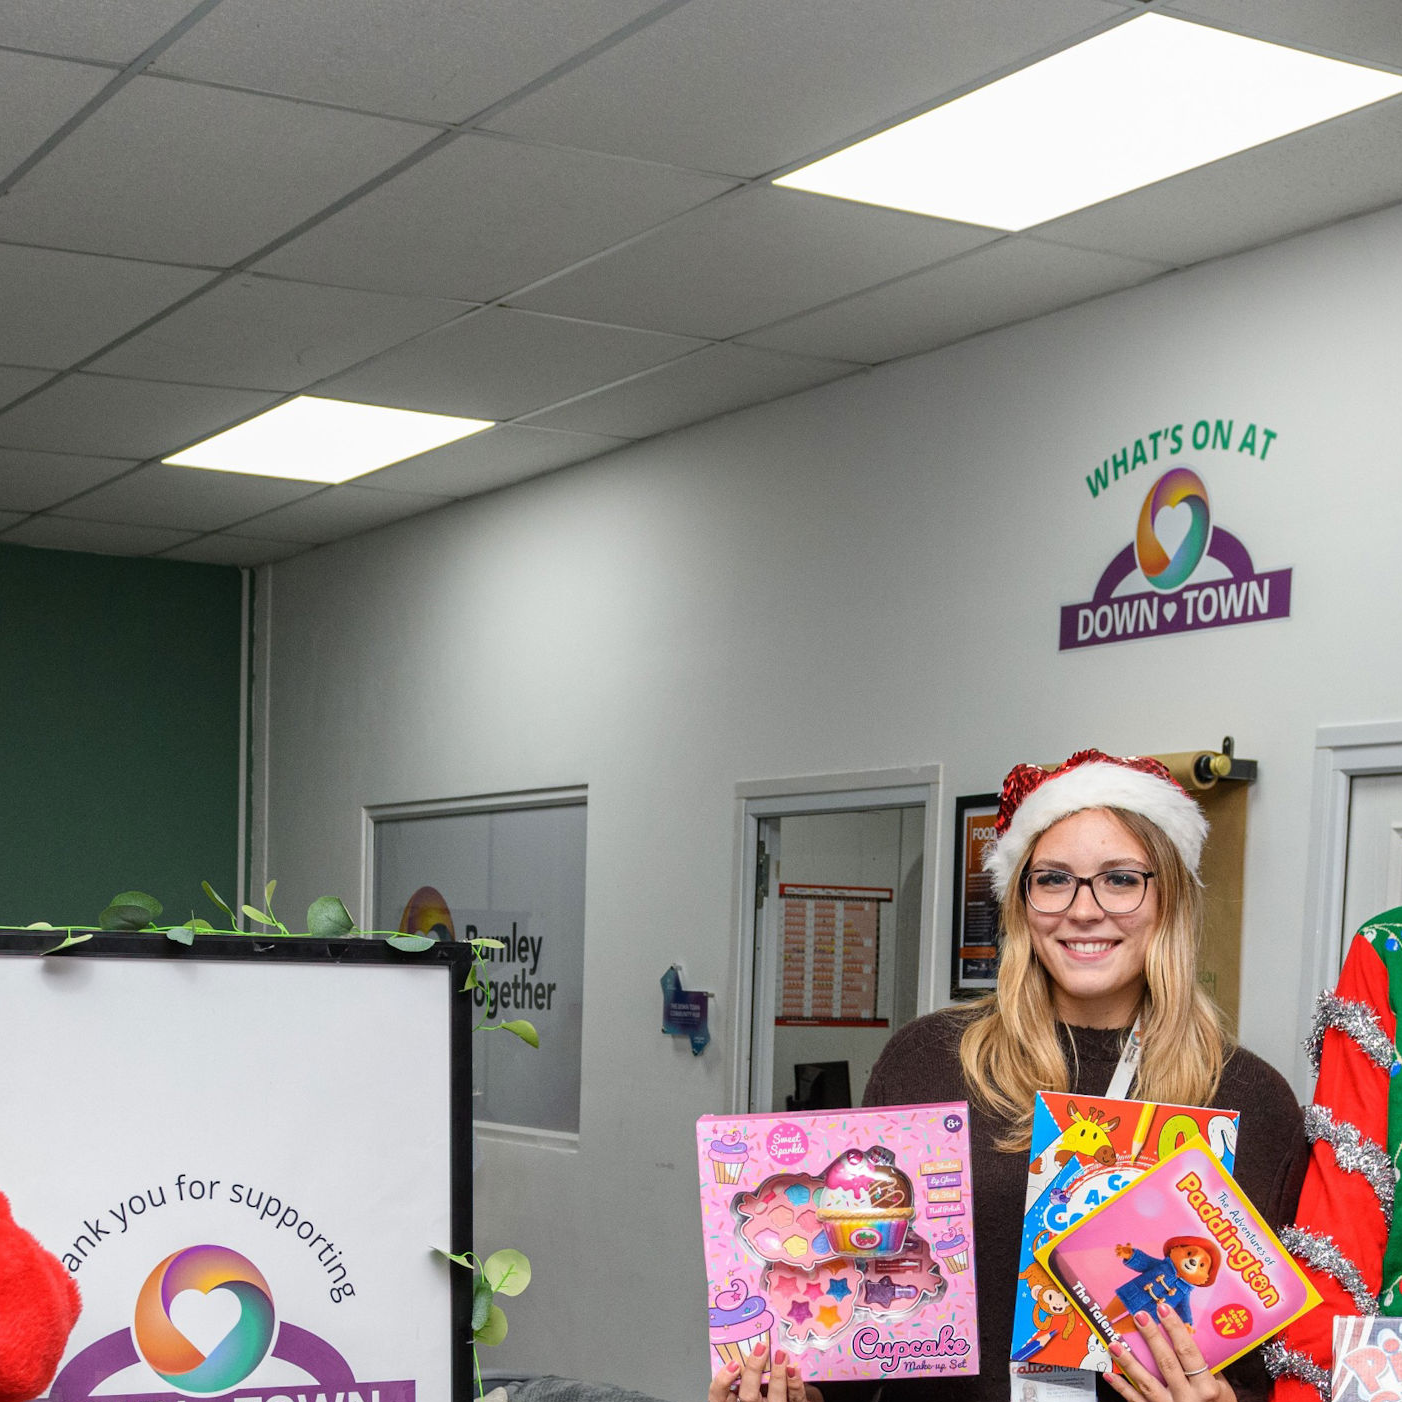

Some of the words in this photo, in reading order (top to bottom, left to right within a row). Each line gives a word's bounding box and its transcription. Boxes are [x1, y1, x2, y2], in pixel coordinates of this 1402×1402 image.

[1085, 424, 1183, 498] WHAT'S
[1192, 420, 1233, 450] ON
[1238, 423, 1277, 461] AT
[1077, 597, 1158, 641] DOWN
[1182, 578, 1270, 625] TOWN
[473, 968, 556, 1019] ogether
[772, 1132, 801, 1145] Sweet
[947, 1119, 960, 1129] 8+
[769, 1142, 806, 1158] Sparkle
[63, 1216, 110, 1279] ank
[109, 1185, 167, 1232] you
[174, 1174, 221, 1201] for
[229, 1182, 356, 1304] supporting
[1176, 1171, 1279, 1309] Paddington
[1217, 1191, 1229, 1209] The
[1229, 1210, 1266, 1257] Adventures
[1264, 1255, 1276, 1267] of
[1072, 1281, 1091, 1304] The
[1089, 1302, 1121, 1342] Talent
[1214, 1313, 1236, 1337] TV
[1229, 1309, 1244, 1330] seen
[1236, 1309, 1248, 1323] As
[853, 1325, 970, 1372] Cupcake
[949, 1359, 967, 1369] Set
